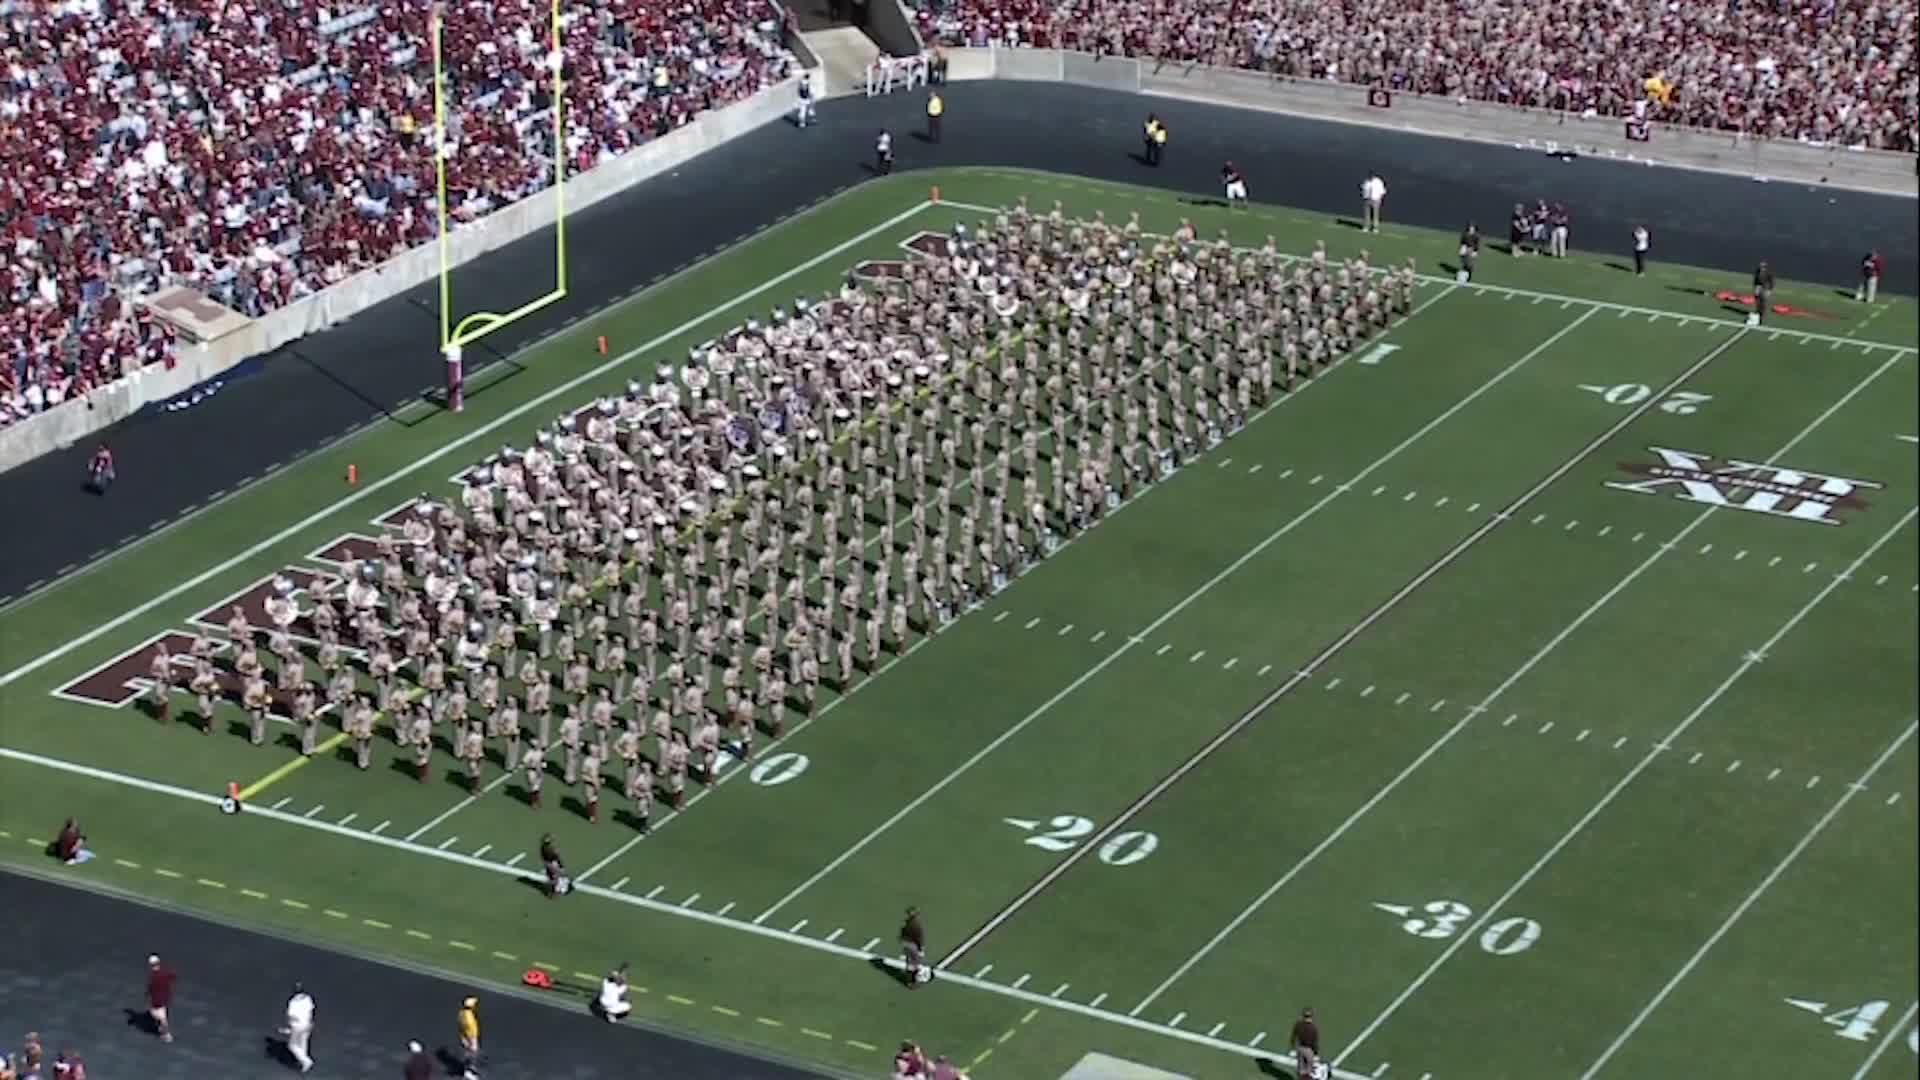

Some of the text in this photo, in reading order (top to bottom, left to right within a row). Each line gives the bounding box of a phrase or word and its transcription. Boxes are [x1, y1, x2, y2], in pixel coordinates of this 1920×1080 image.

[1604, 383, 1713, 415] 20
[1021, 815, 1159, 867] 20
[1402, 900, 1542, 956] 30
